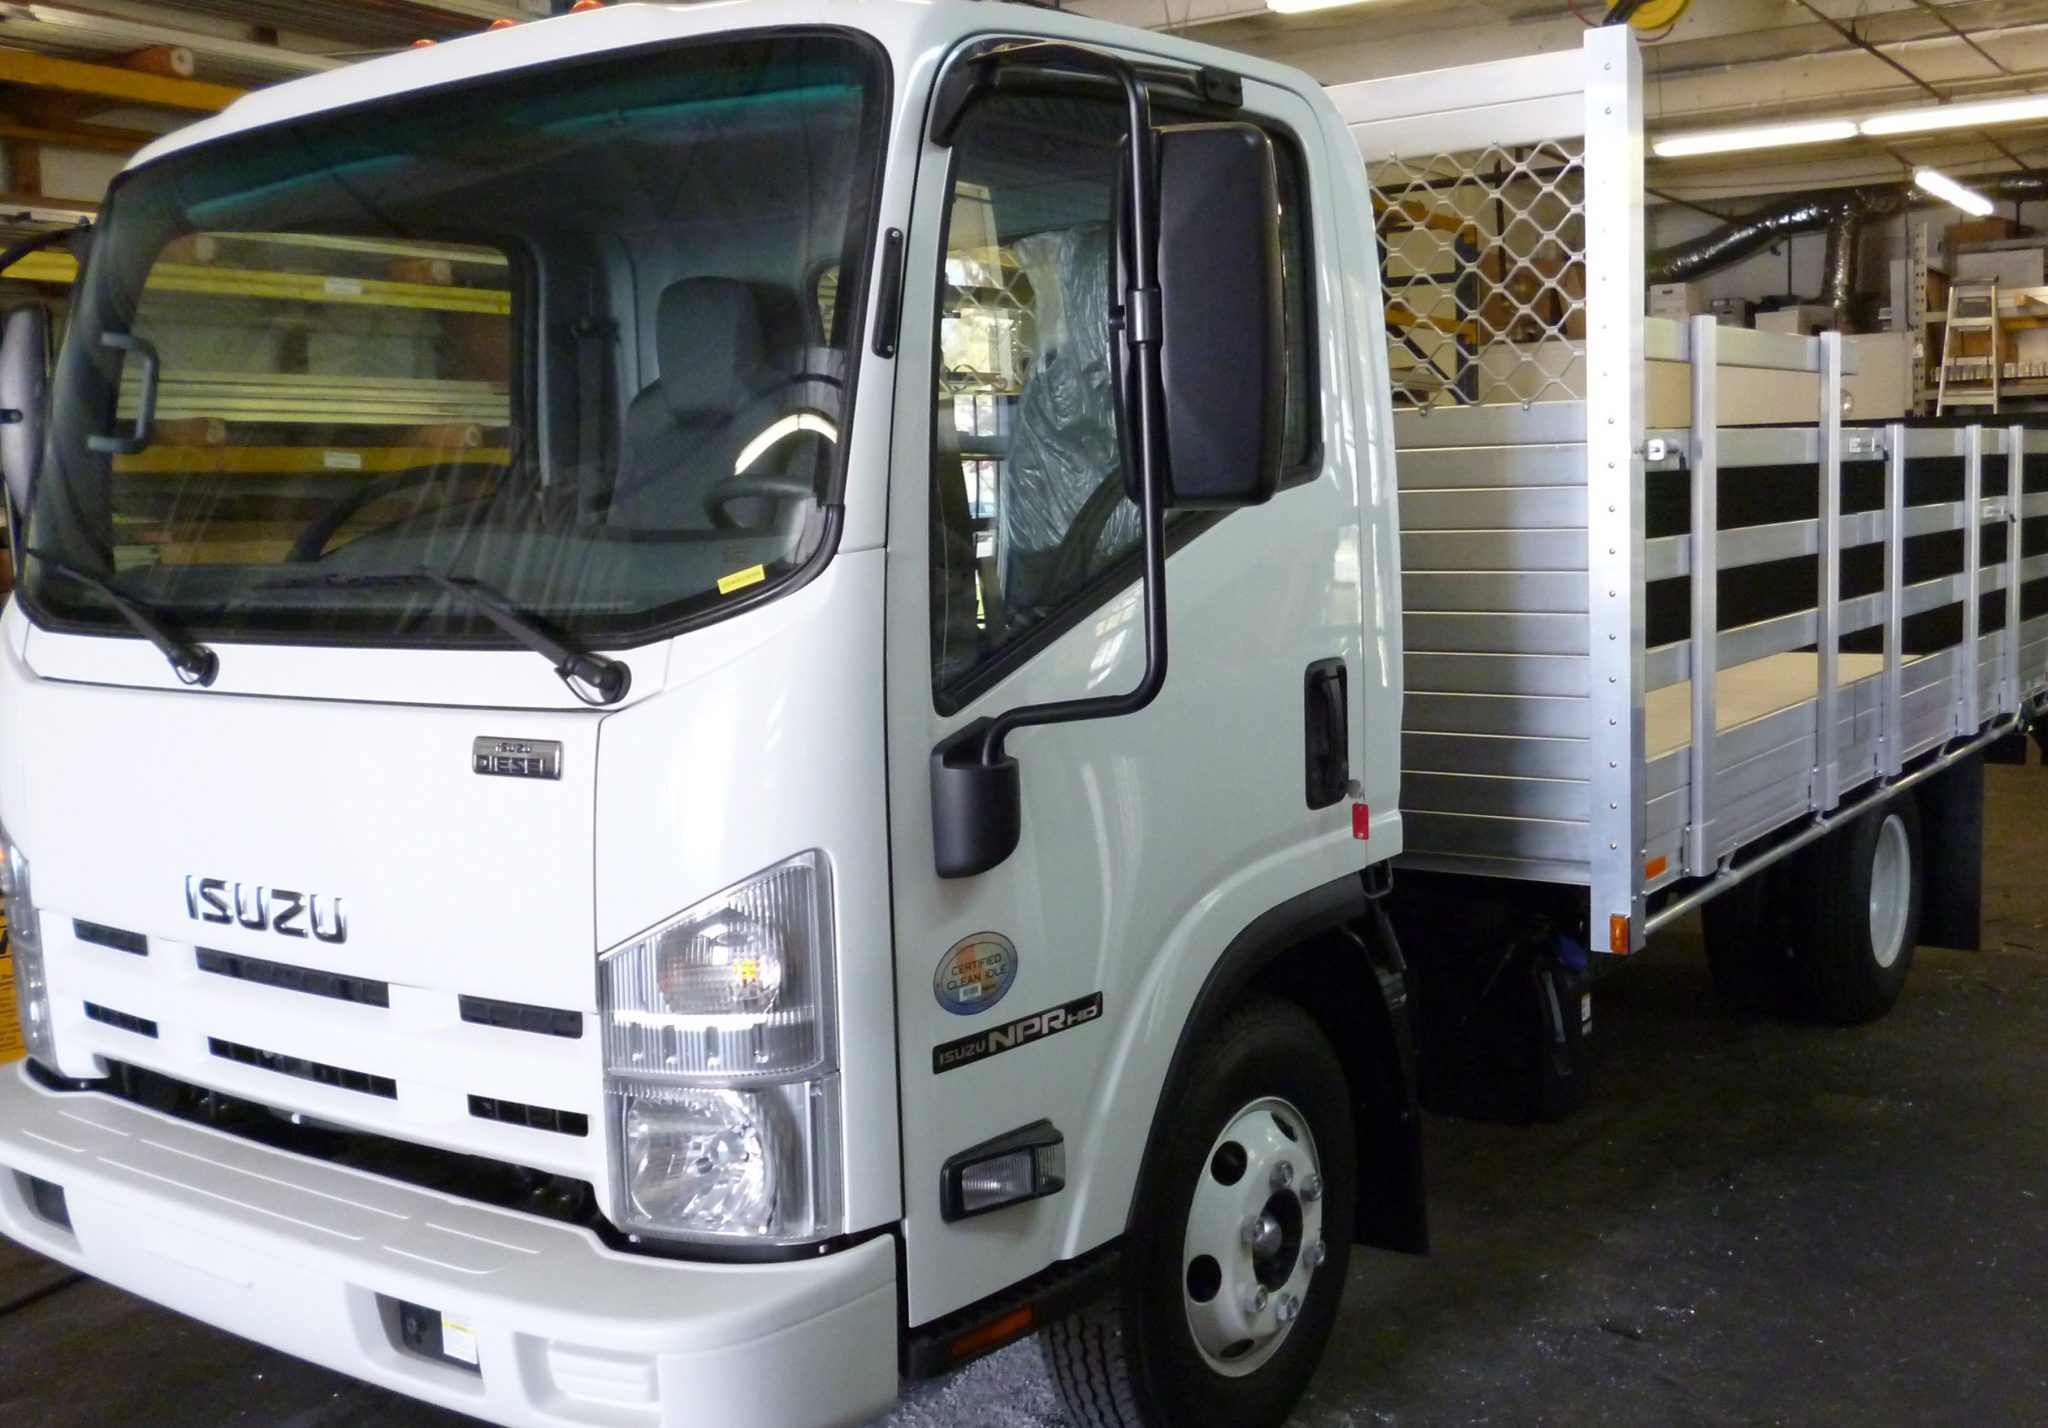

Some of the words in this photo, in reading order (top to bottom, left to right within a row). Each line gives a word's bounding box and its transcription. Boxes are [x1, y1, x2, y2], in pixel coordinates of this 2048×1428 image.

[495, 742, 532, 753] ISUZU
[473, 754, 556, 776] DIESEL
[185, 874, 348, 945] ISUZU
[951, 953, 1002, 976] CERTIFIED
[946, 972, 982, 991] CLEAN
[939, 1039, 986, 1066] ISUZU
